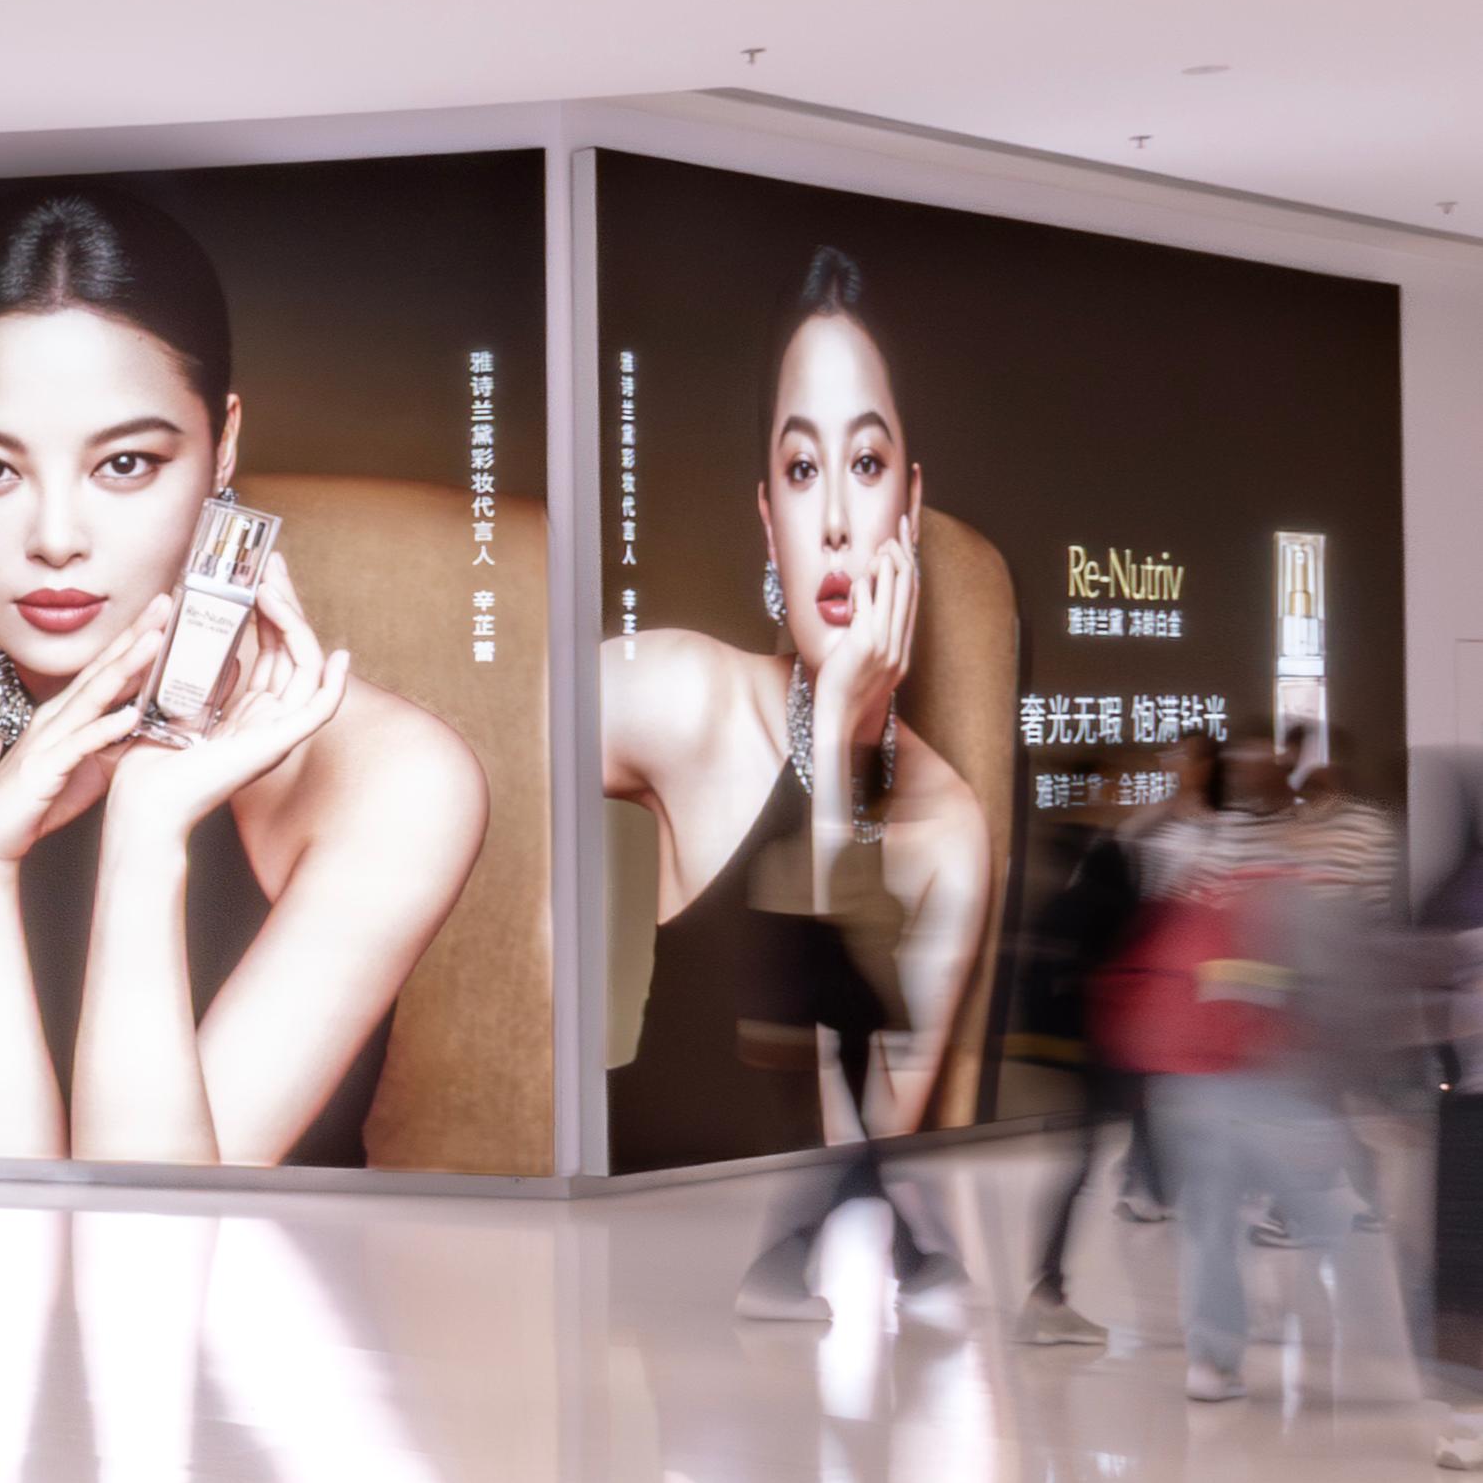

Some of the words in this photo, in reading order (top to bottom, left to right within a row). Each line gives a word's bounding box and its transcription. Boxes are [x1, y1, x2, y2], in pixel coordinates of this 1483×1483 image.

[469, 351, 495, 566] 雅诗兰黛彩妆代言人
[1067, 545, 1184, 601] Re-Nutriv
[1019, 693, 1123, 746] 奢光无瑕
